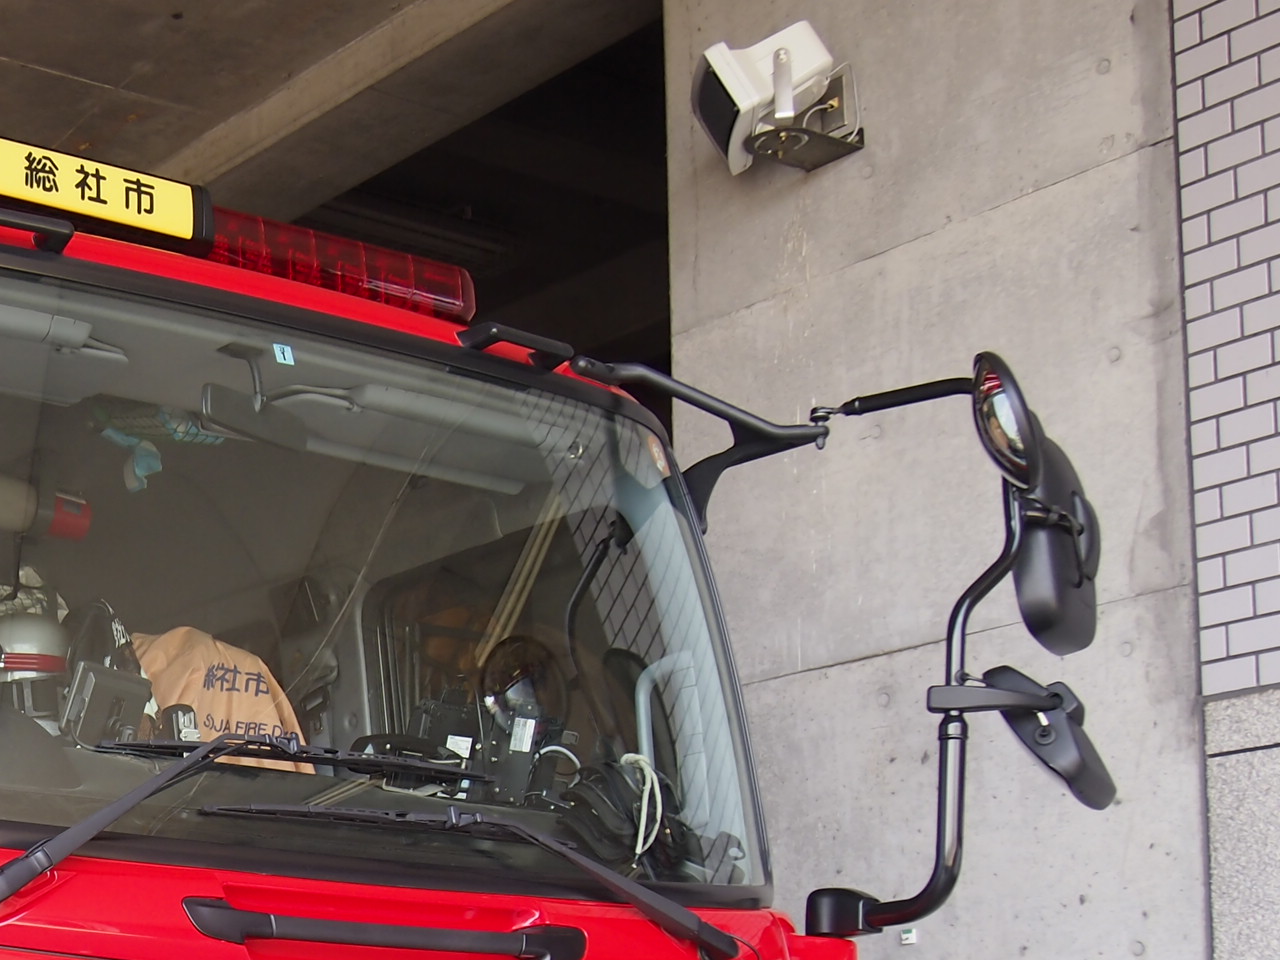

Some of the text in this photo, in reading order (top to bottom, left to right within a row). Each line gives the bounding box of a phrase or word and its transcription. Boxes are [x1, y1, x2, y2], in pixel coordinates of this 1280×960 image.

[24, 151, 156, 215] 総社市
[234, 720, 268, 736] FIRE
